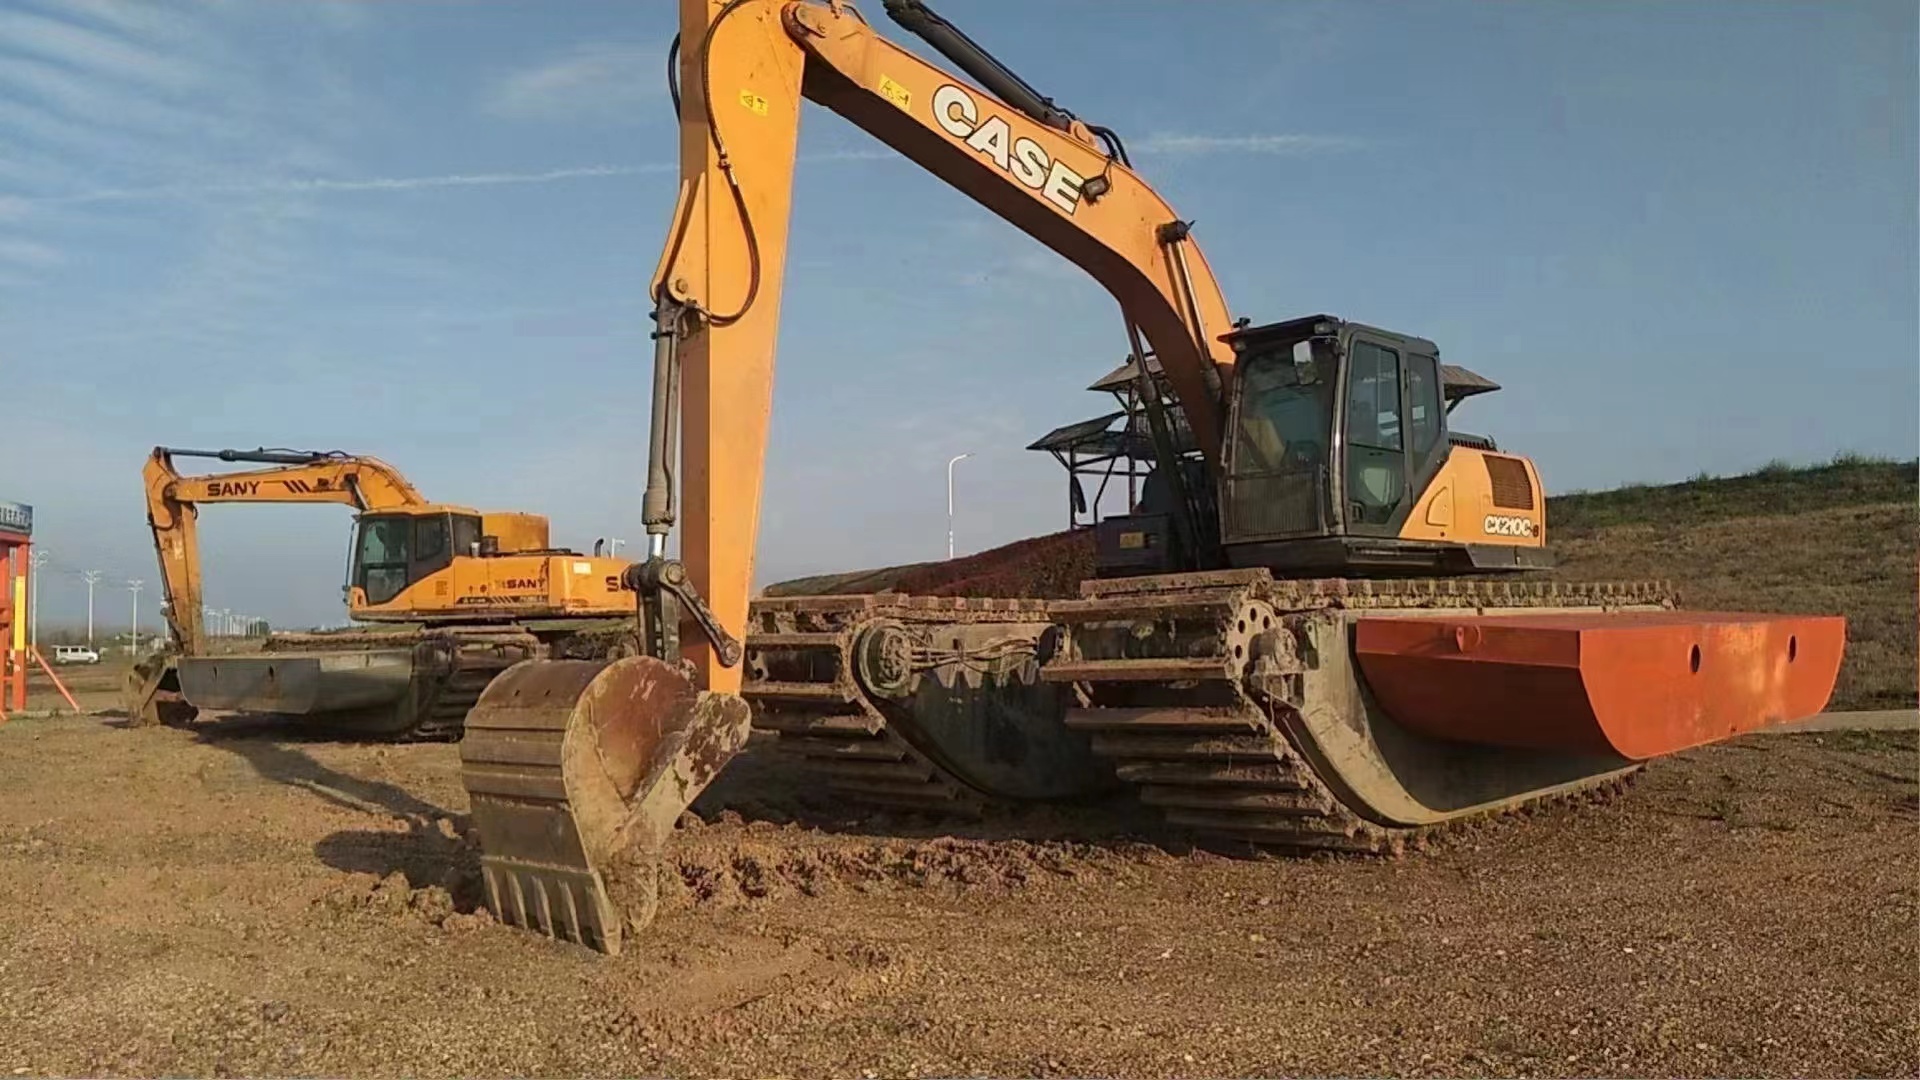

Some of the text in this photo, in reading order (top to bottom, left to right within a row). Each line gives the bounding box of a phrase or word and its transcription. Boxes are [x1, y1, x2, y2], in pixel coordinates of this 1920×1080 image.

[932, 84, 1085, 216] CASE
[207, 481, 260, 496] SANY
[507, 579, 545, 589] SANY
